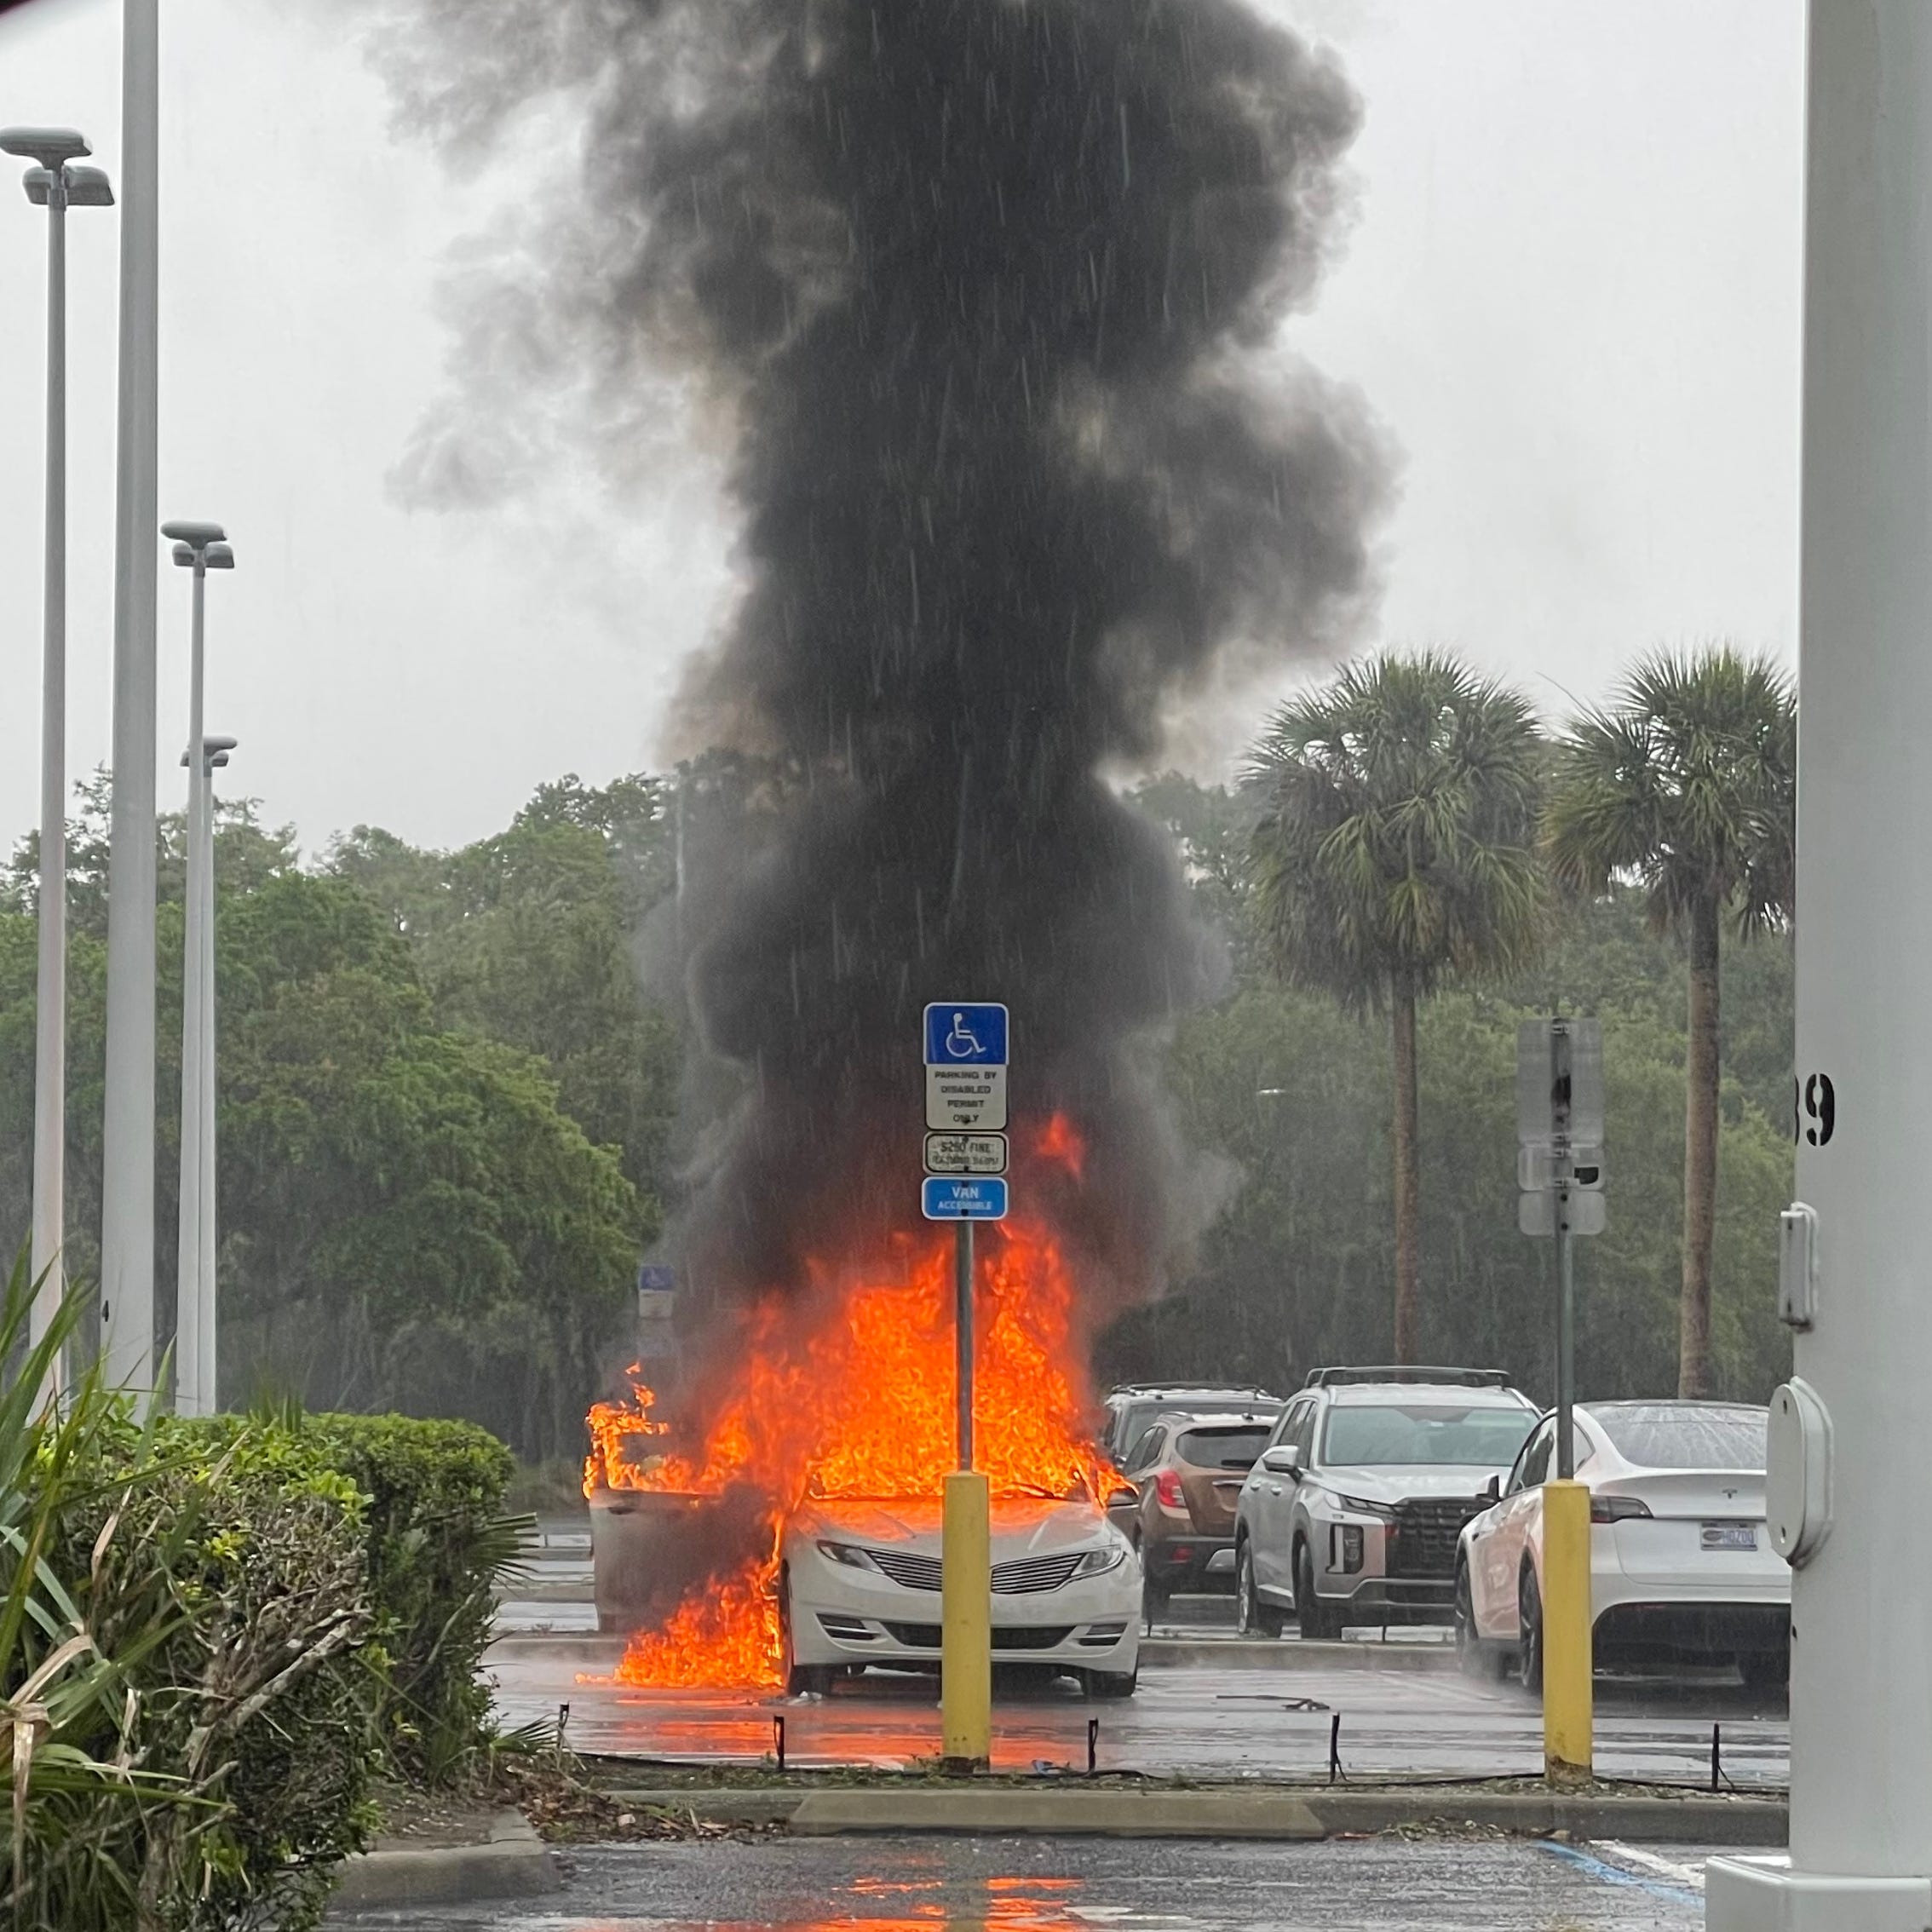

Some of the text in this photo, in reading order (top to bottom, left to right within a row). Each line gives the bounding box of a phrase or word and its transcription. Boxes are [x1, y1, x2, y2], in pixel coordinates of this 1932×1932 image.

[934, 1071, 997, 1079] PARKING BY
[940, 1085, 992, 1094] DISABLED
[947, 1100, 984, 1108] PERMIT
[1794, 1073, 1834, 1146] 9
[952, 1186, 979, 1199] VAN
[937, 1200, 992, 1210] ACCESSIBLE
